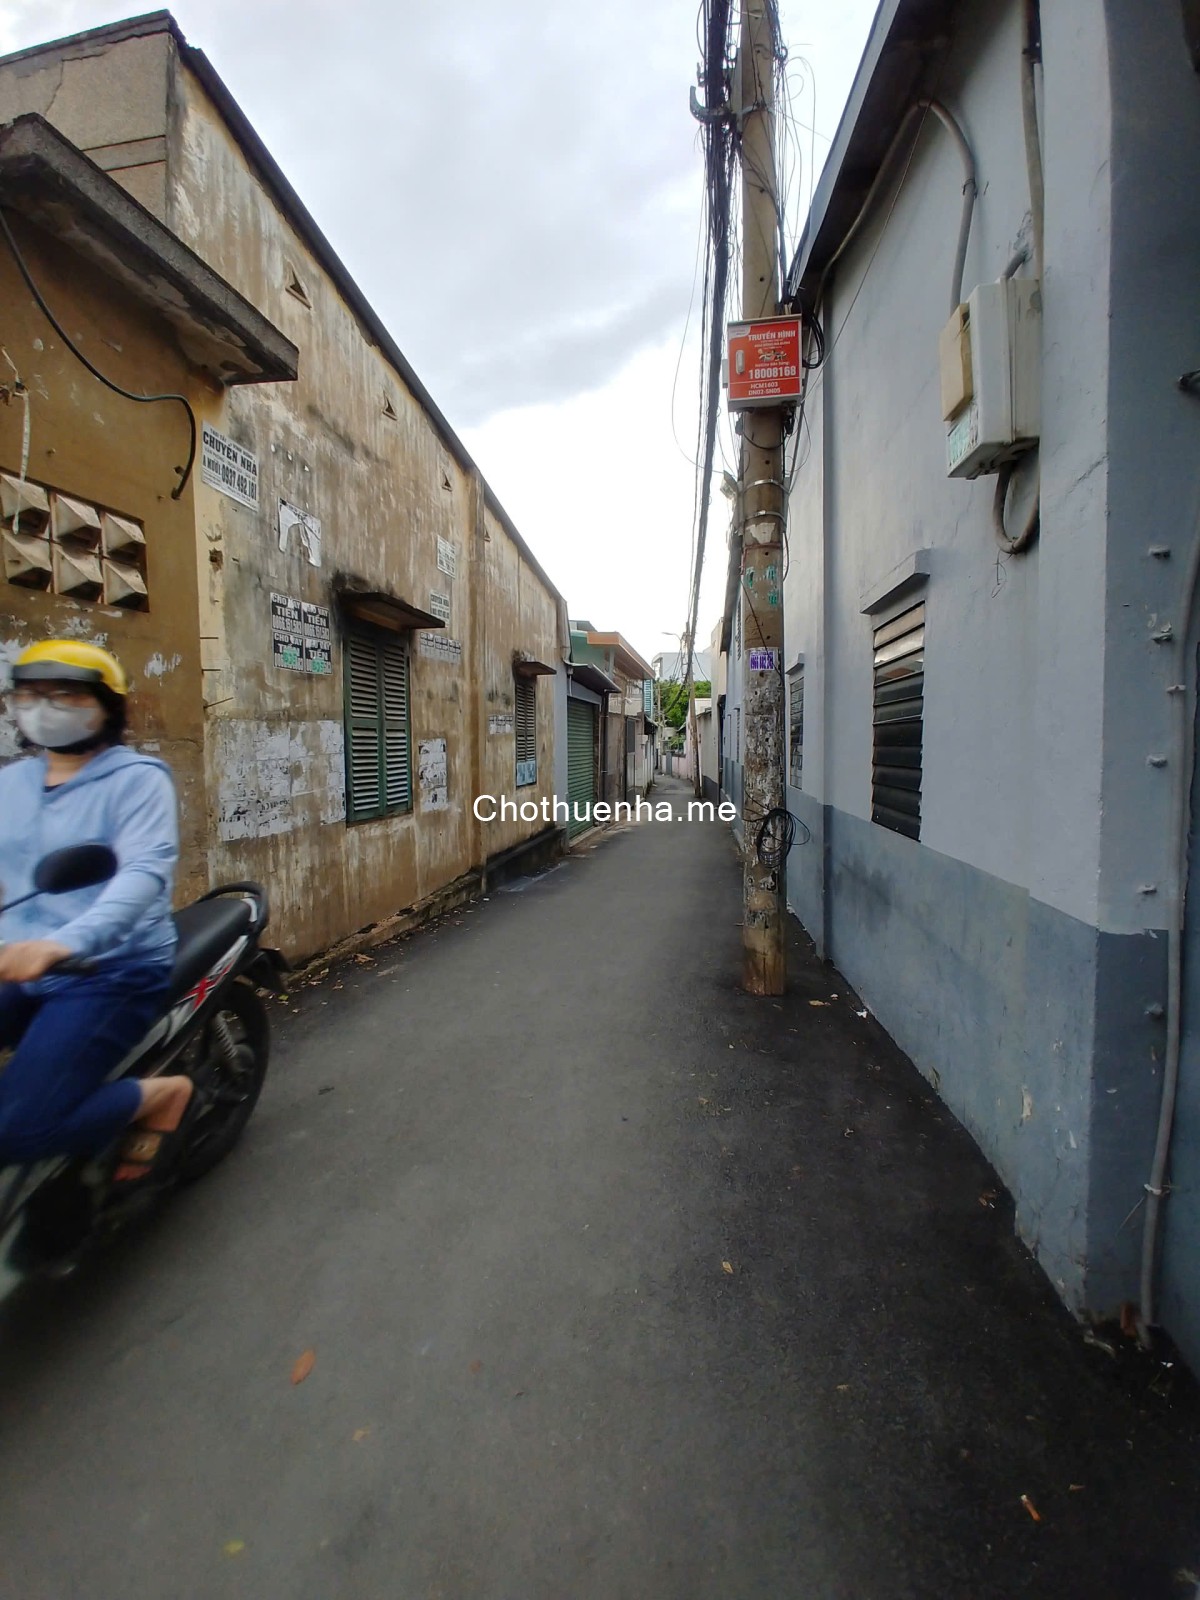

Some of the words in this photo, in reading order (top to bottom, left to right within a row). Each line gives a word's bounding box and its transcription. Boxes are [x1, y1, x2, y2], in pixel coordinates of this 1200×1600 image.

[777, 330, 796, 338] HÌNH
[748, 365, 797, 380] 18008168
[750, 381, 779, 390] HCM1603
[272, 593, 287, 605] CHO
[274, 632, 289, 643] CHO
